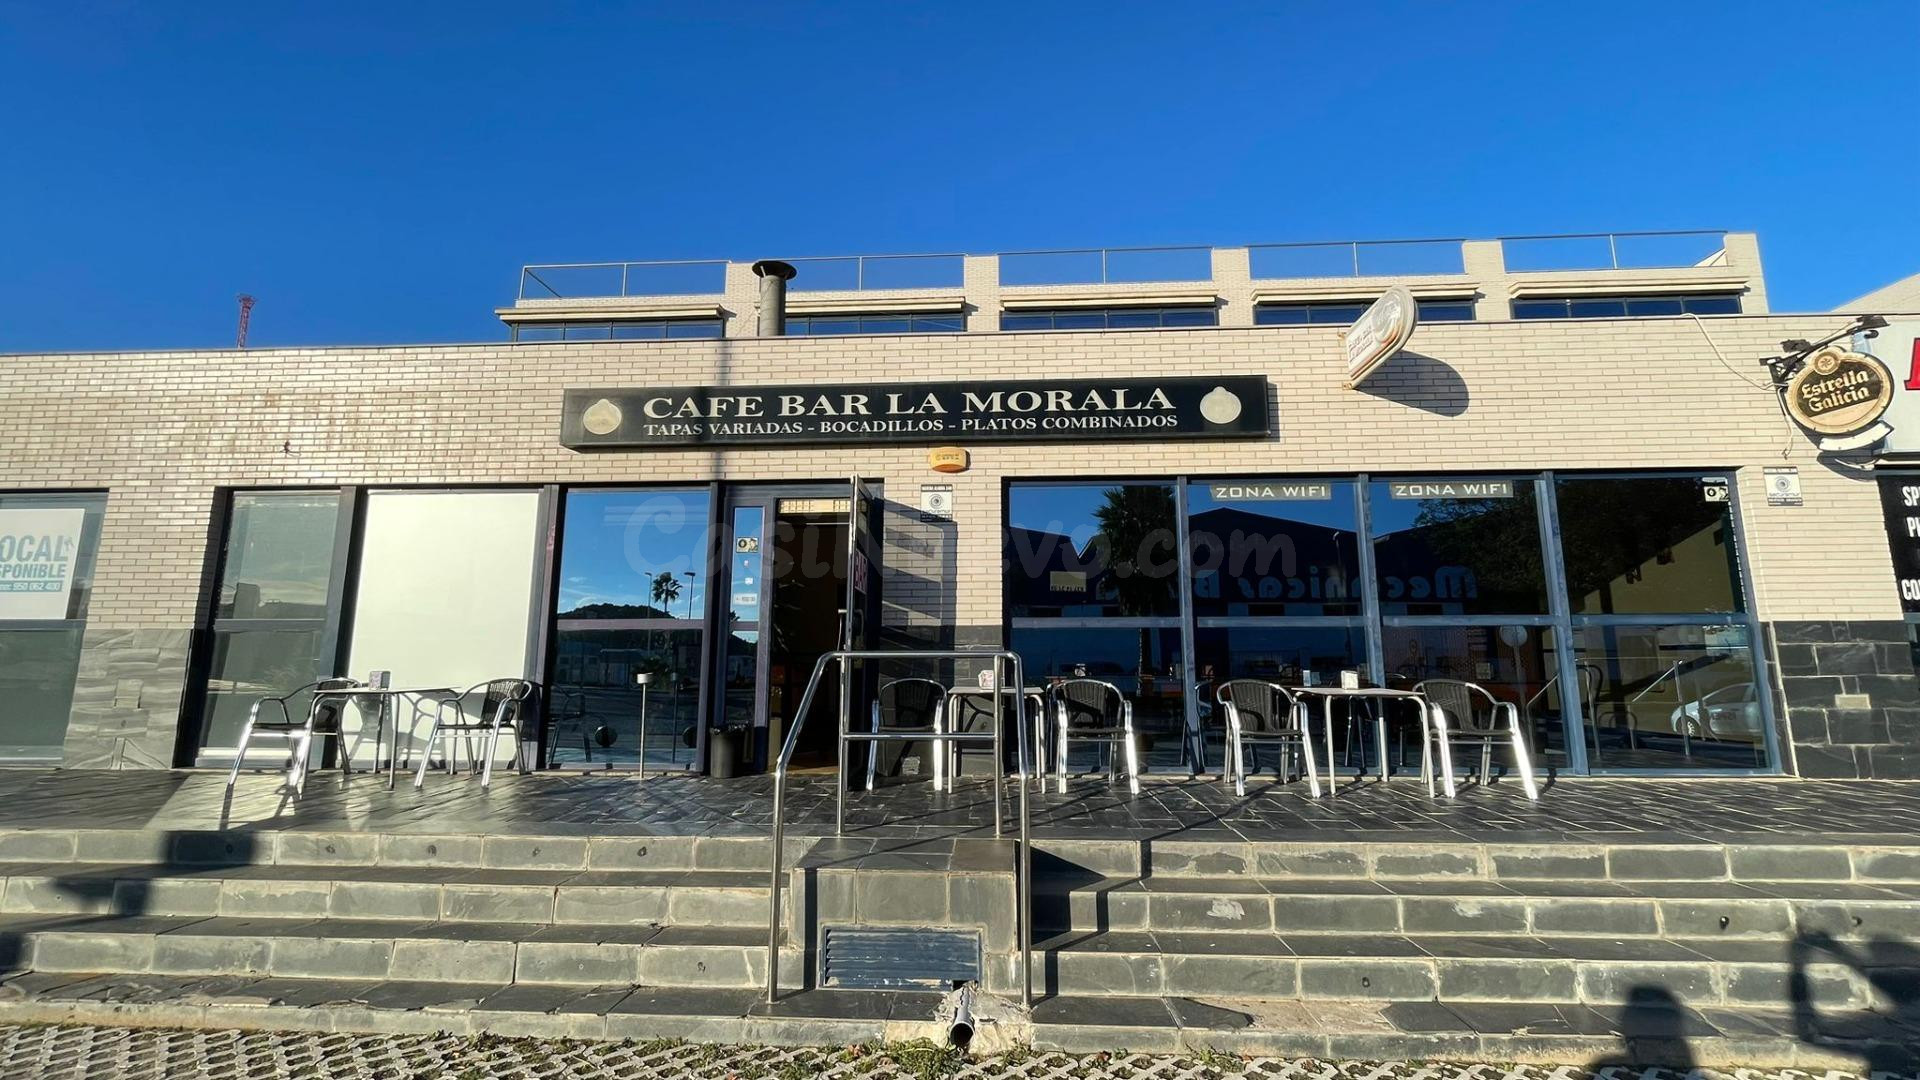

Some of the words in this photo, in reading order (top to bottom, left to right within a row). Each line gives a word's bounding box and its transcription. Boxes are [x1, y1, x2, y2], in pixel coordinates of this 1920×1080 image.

[1801, 370, 1869, 399] Estrella
[643, 396, 764, 419] CAFE
[777, 394, 872, 416] BAR
[886, 392, 948, 415] LA
[961, 387, 1177, 413] MORALA
[1808, 387, 1870, 412] Galicia
[643, 423, 703, 436] TAPAS
[709, 421, 802, 435] VARIADAS
[820, 418, 943, 434] BOCADILLOS
[962, 416, 1037, 431] PLATOS
[1042, 414, 1178, 430] COMBINADOS
[1216, 486, 1275, 498] ZONA
[1283, 485, 1326, 497] WIFI
[1395, 484, 1456, 496] ZONA
[1463, 483, 1507, 495] WIFI
[1902, 485, 1920, 507] SP
[1901, 578, 1920, 601] CO
